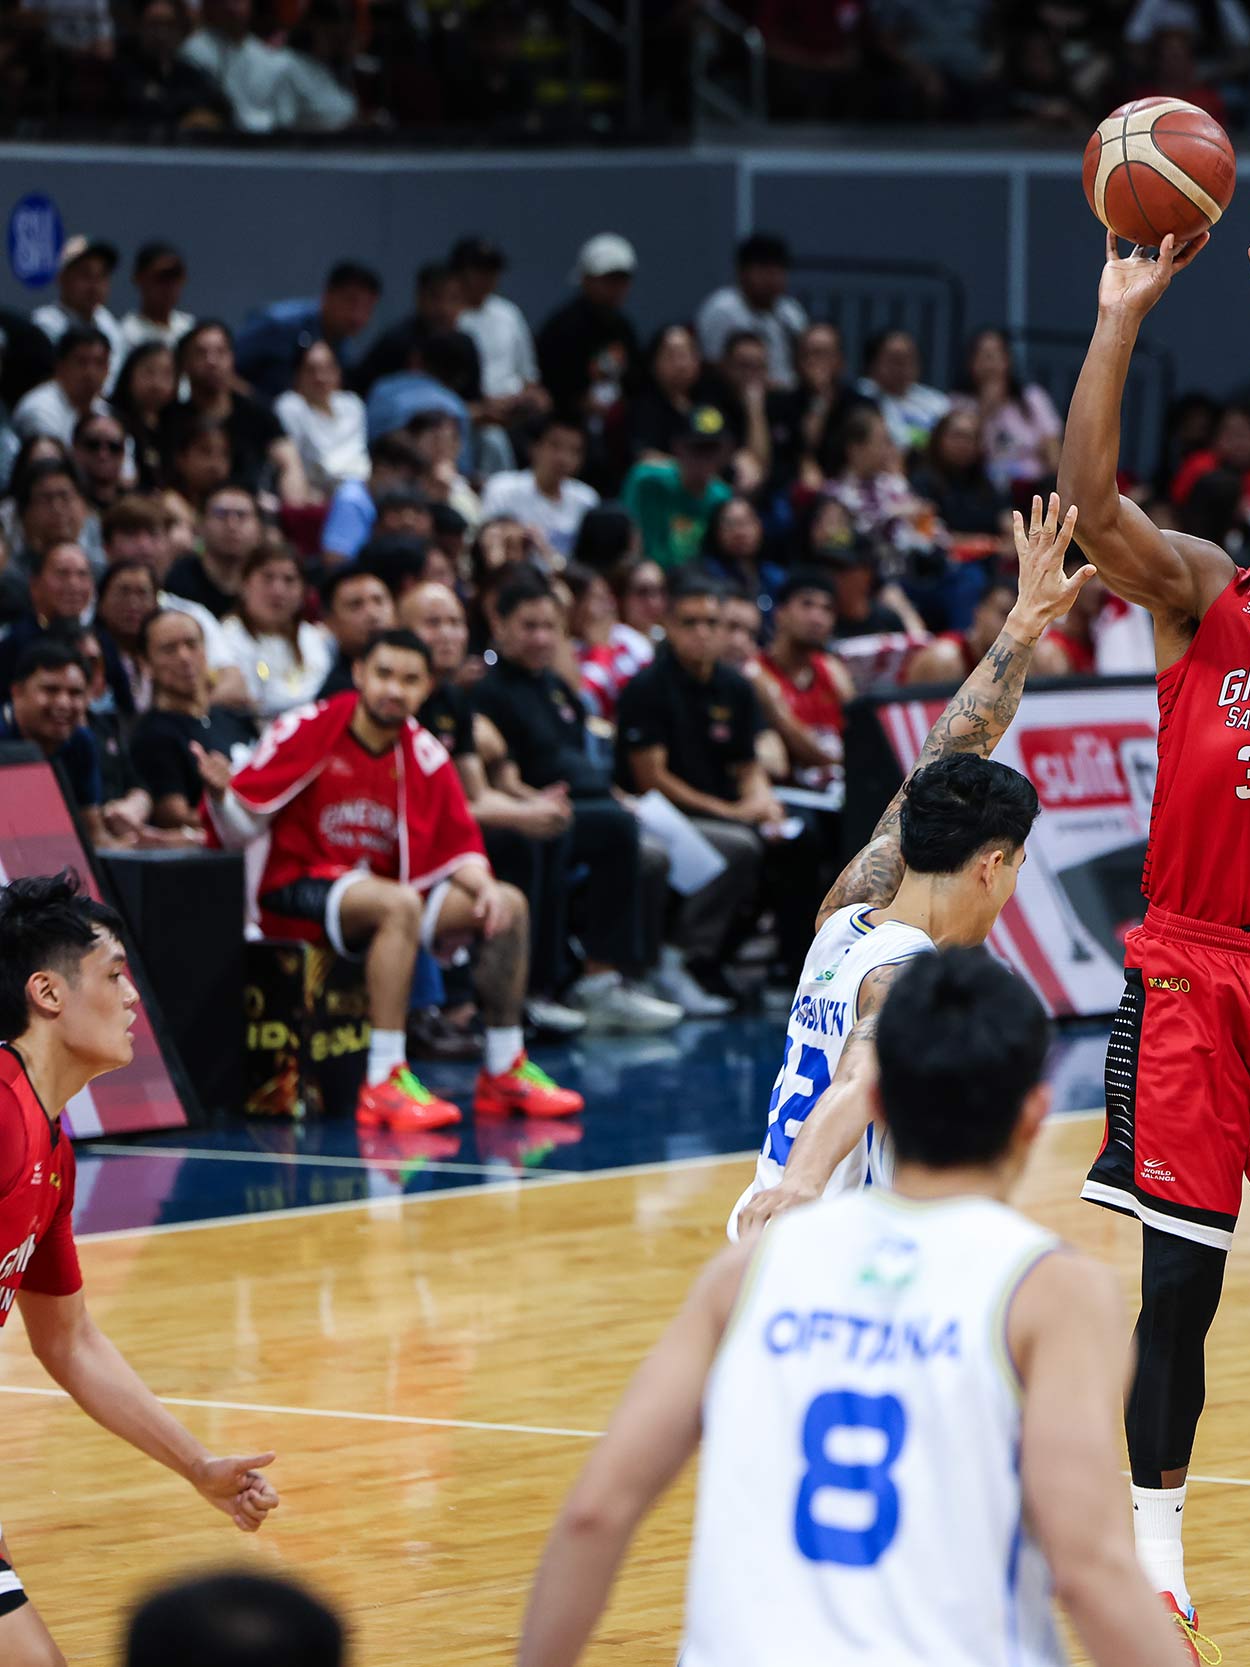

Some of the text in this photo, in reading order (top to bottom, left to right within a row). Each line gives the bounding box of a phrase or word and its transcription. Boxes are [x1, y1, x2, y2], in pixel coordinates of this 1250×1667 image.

[1033, 734, 1124, 800] sulit
[1144, 1167, 1172, 1176] WORLD
[793, 1390, 907, 1567] 8
